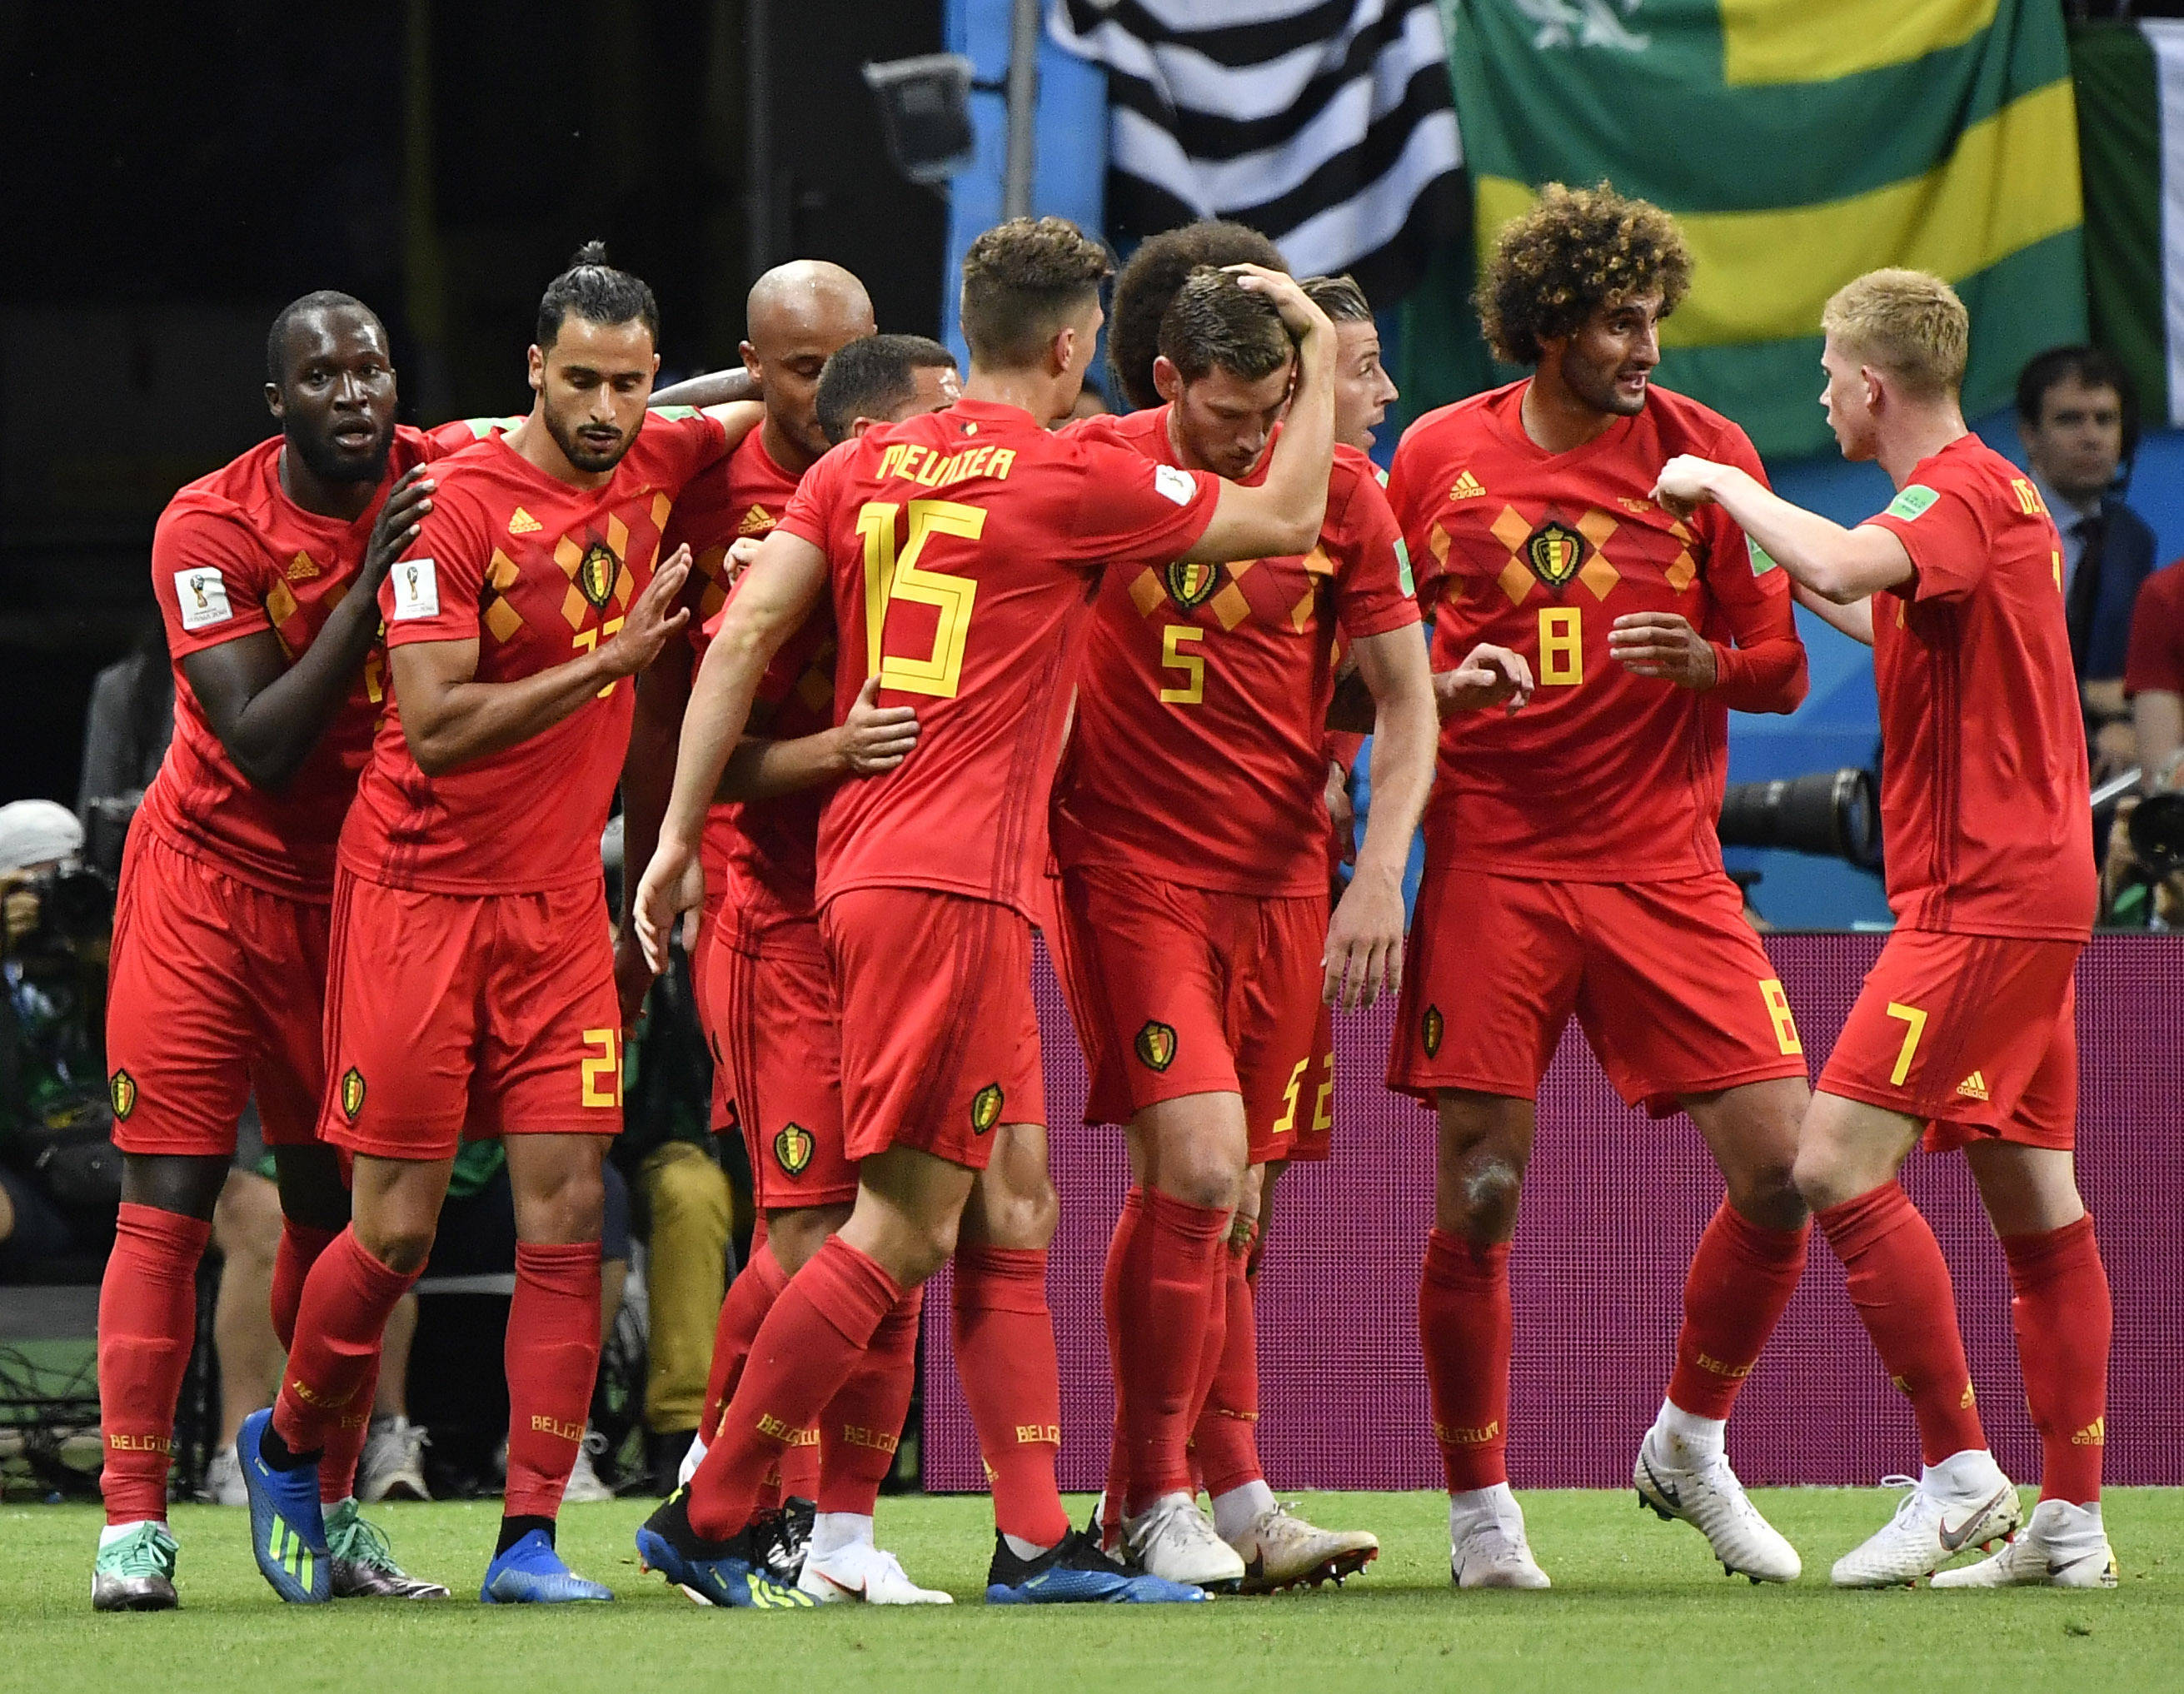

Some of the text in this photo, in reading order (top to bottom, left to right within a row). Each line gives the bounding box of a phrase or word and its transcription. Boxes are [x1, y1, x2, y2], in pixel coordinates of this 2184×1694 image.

[876, 444, 1017, 486] MEUNIER
[1449, 486, 1486, 501] adidas
[739, 518, 776, 534] adidas
[856, 500, 987, 698] 15
[1160, 625, 1204, 704] 5
[1538, 607, 1583, 685] 8
[1759, 979, 1803, 1055] 8
[1887, 1002, 1927, 1086] 7
[1273, 1055, 1309, 1133] 5
[1957, 1086, 1989, 1101] adidas
[1016, 1425, 1060, 1447] BELG
